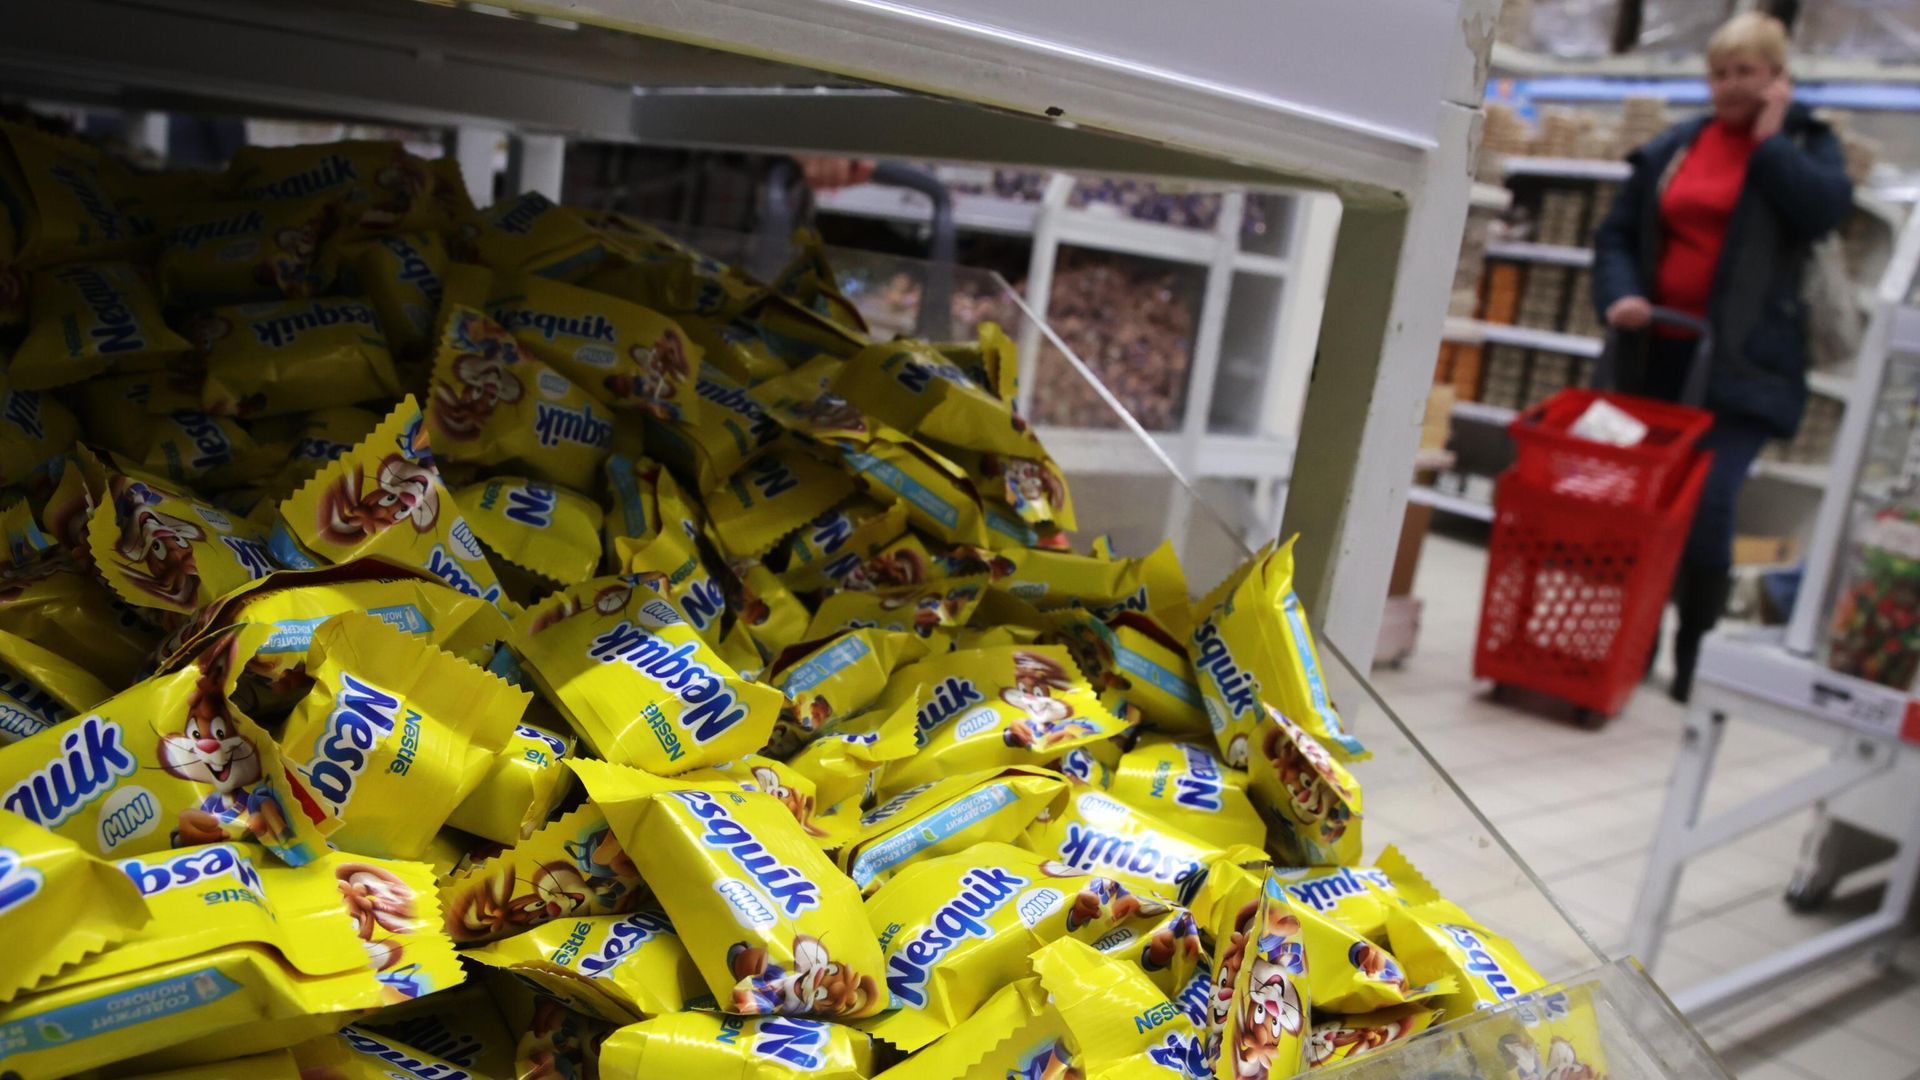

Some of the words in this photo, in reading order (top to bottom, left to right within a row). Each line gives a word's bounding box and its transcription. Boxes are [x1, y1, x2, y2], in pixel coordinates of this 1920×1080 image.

[591, 624, 744, 741] Nesquik
[298, 675, 399, 808] Nesq
[388, 709, 422, 776] Nestlé
[641, 703, 686, 762] Nestlé
[958, 710, 994, 738] MINI
[103, 793, 154, 847] MINI
[945, 802, 993, 832] СОДЕРЖИТ
[950, 794, 989, 818] МОЛОКО
[1021, 889, 1058, 925] MINI
[551, 921, 592, 966] estlé
[887, 868, 1024, 1006] Nesquik
[91, 995, 189, 1031] СОДЕРЖИТ
[106, 981, 187, 1012] МОЛОКО
